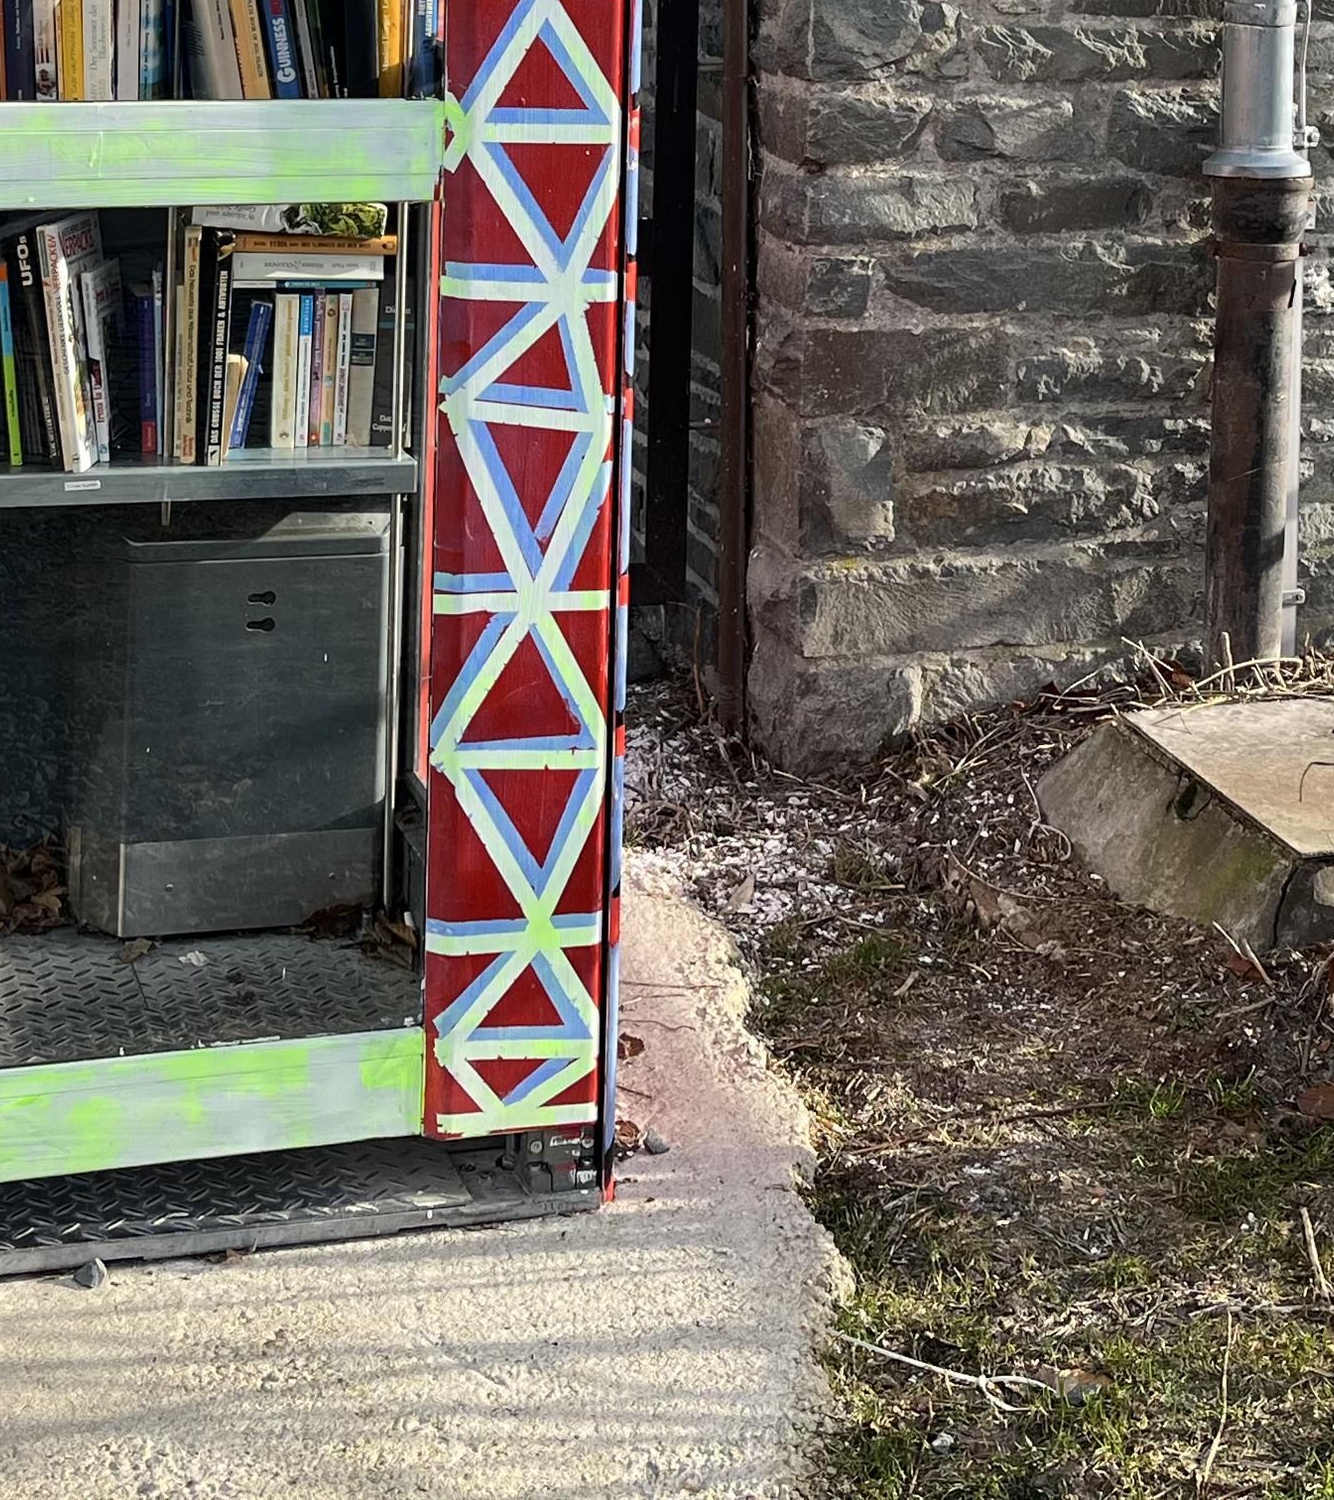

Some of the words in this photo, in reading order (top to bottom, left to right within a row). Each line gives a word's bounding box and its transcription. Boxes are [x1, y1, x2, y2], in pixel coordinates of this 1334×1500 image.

[89, 4, 98, 18] der
[90, 20, 98, 53] Sommer
[272, 17, 296, 83] GUINNESS
[16, 236, 34, 286] UFOs
[46, 234, 62, 294] VERPACKEN
[188, 265, 196, 278] Das
[187, 279, 195, 307] Neueste
[218, 270, 228, 310] ANTWORTEN
[55, 295, 65, 332] LIEBEVOLL
[216, 320, 226, 346] FRAGEN
[214, 364, 222, 379] DER
[213, 380, 222, 400] BUCH
[94, 399, 105, 423] Irma
[212, 401, 220, 428] GROSSE
[210, 430, 219, 444] DAS
